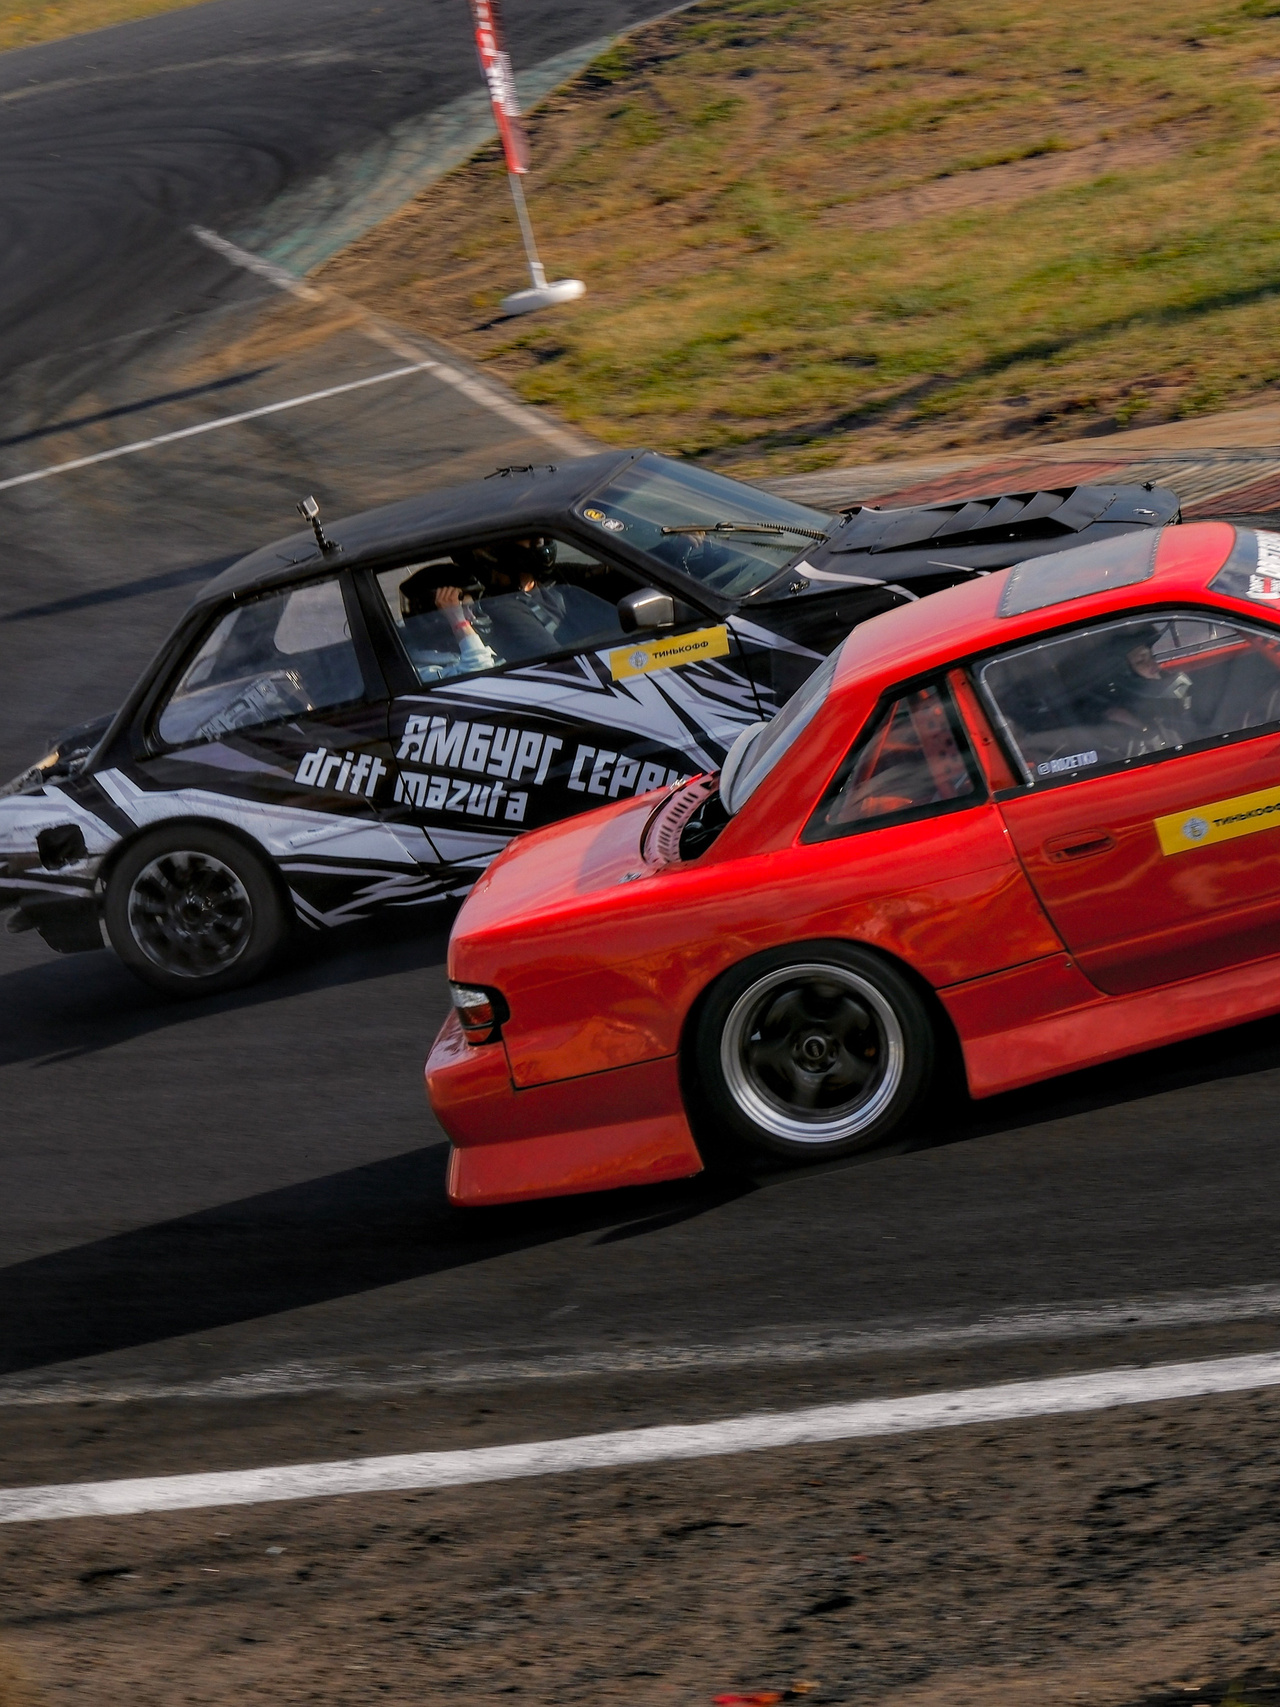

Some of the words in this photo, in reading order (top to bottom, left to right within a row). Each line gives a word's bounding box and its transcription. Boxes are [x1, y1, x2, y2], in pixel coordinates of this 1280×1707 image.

[652, 640, 709, 660] ТИНЬКОФФ
[294, 746, 387, 798] drift
[393, 771, 529, 823] mazuta
[396, 714, 563, 786] ЯМБУРГ
